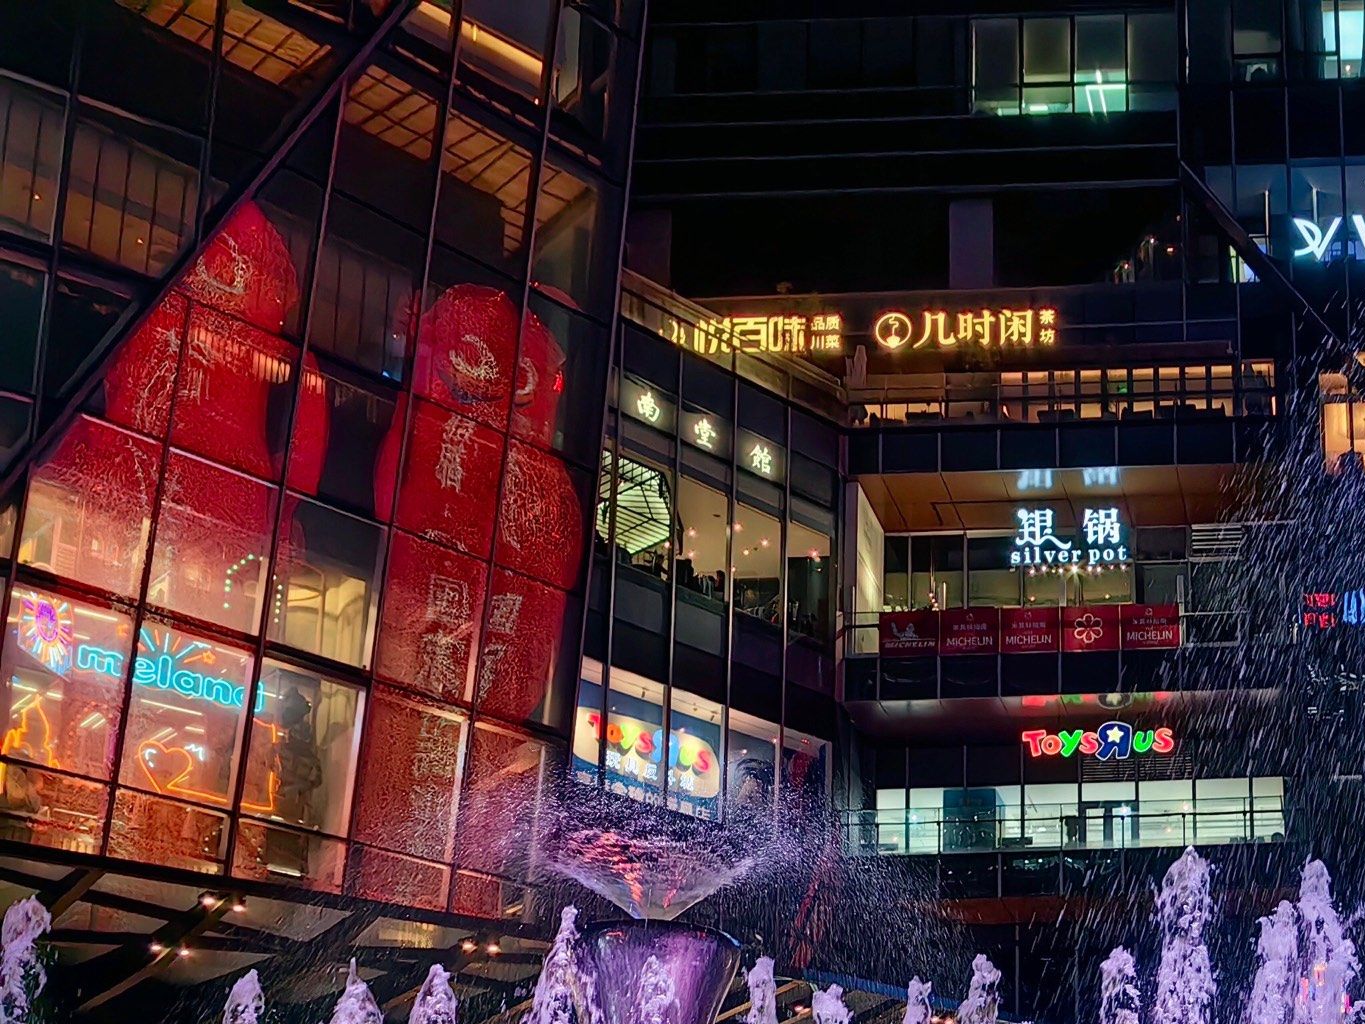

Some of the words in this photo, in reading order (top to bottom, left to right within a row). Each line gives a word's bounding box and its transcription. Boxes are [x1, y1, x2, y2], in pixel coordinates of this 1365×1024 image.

[913, 310, 1034, 349] 几时闲
[1040, 310, 1057, 344] 茶坊
[1010, 546, 1082, 564] silver
[1087, 545, 1127, 565] pot
[946, 636, 993, 646] MICHELIN
[1006, 634, 1052, 645] MICHELIN
[1127, 631, 1173, 641] MICHELIN
[77, 644, 264, 714] meland
